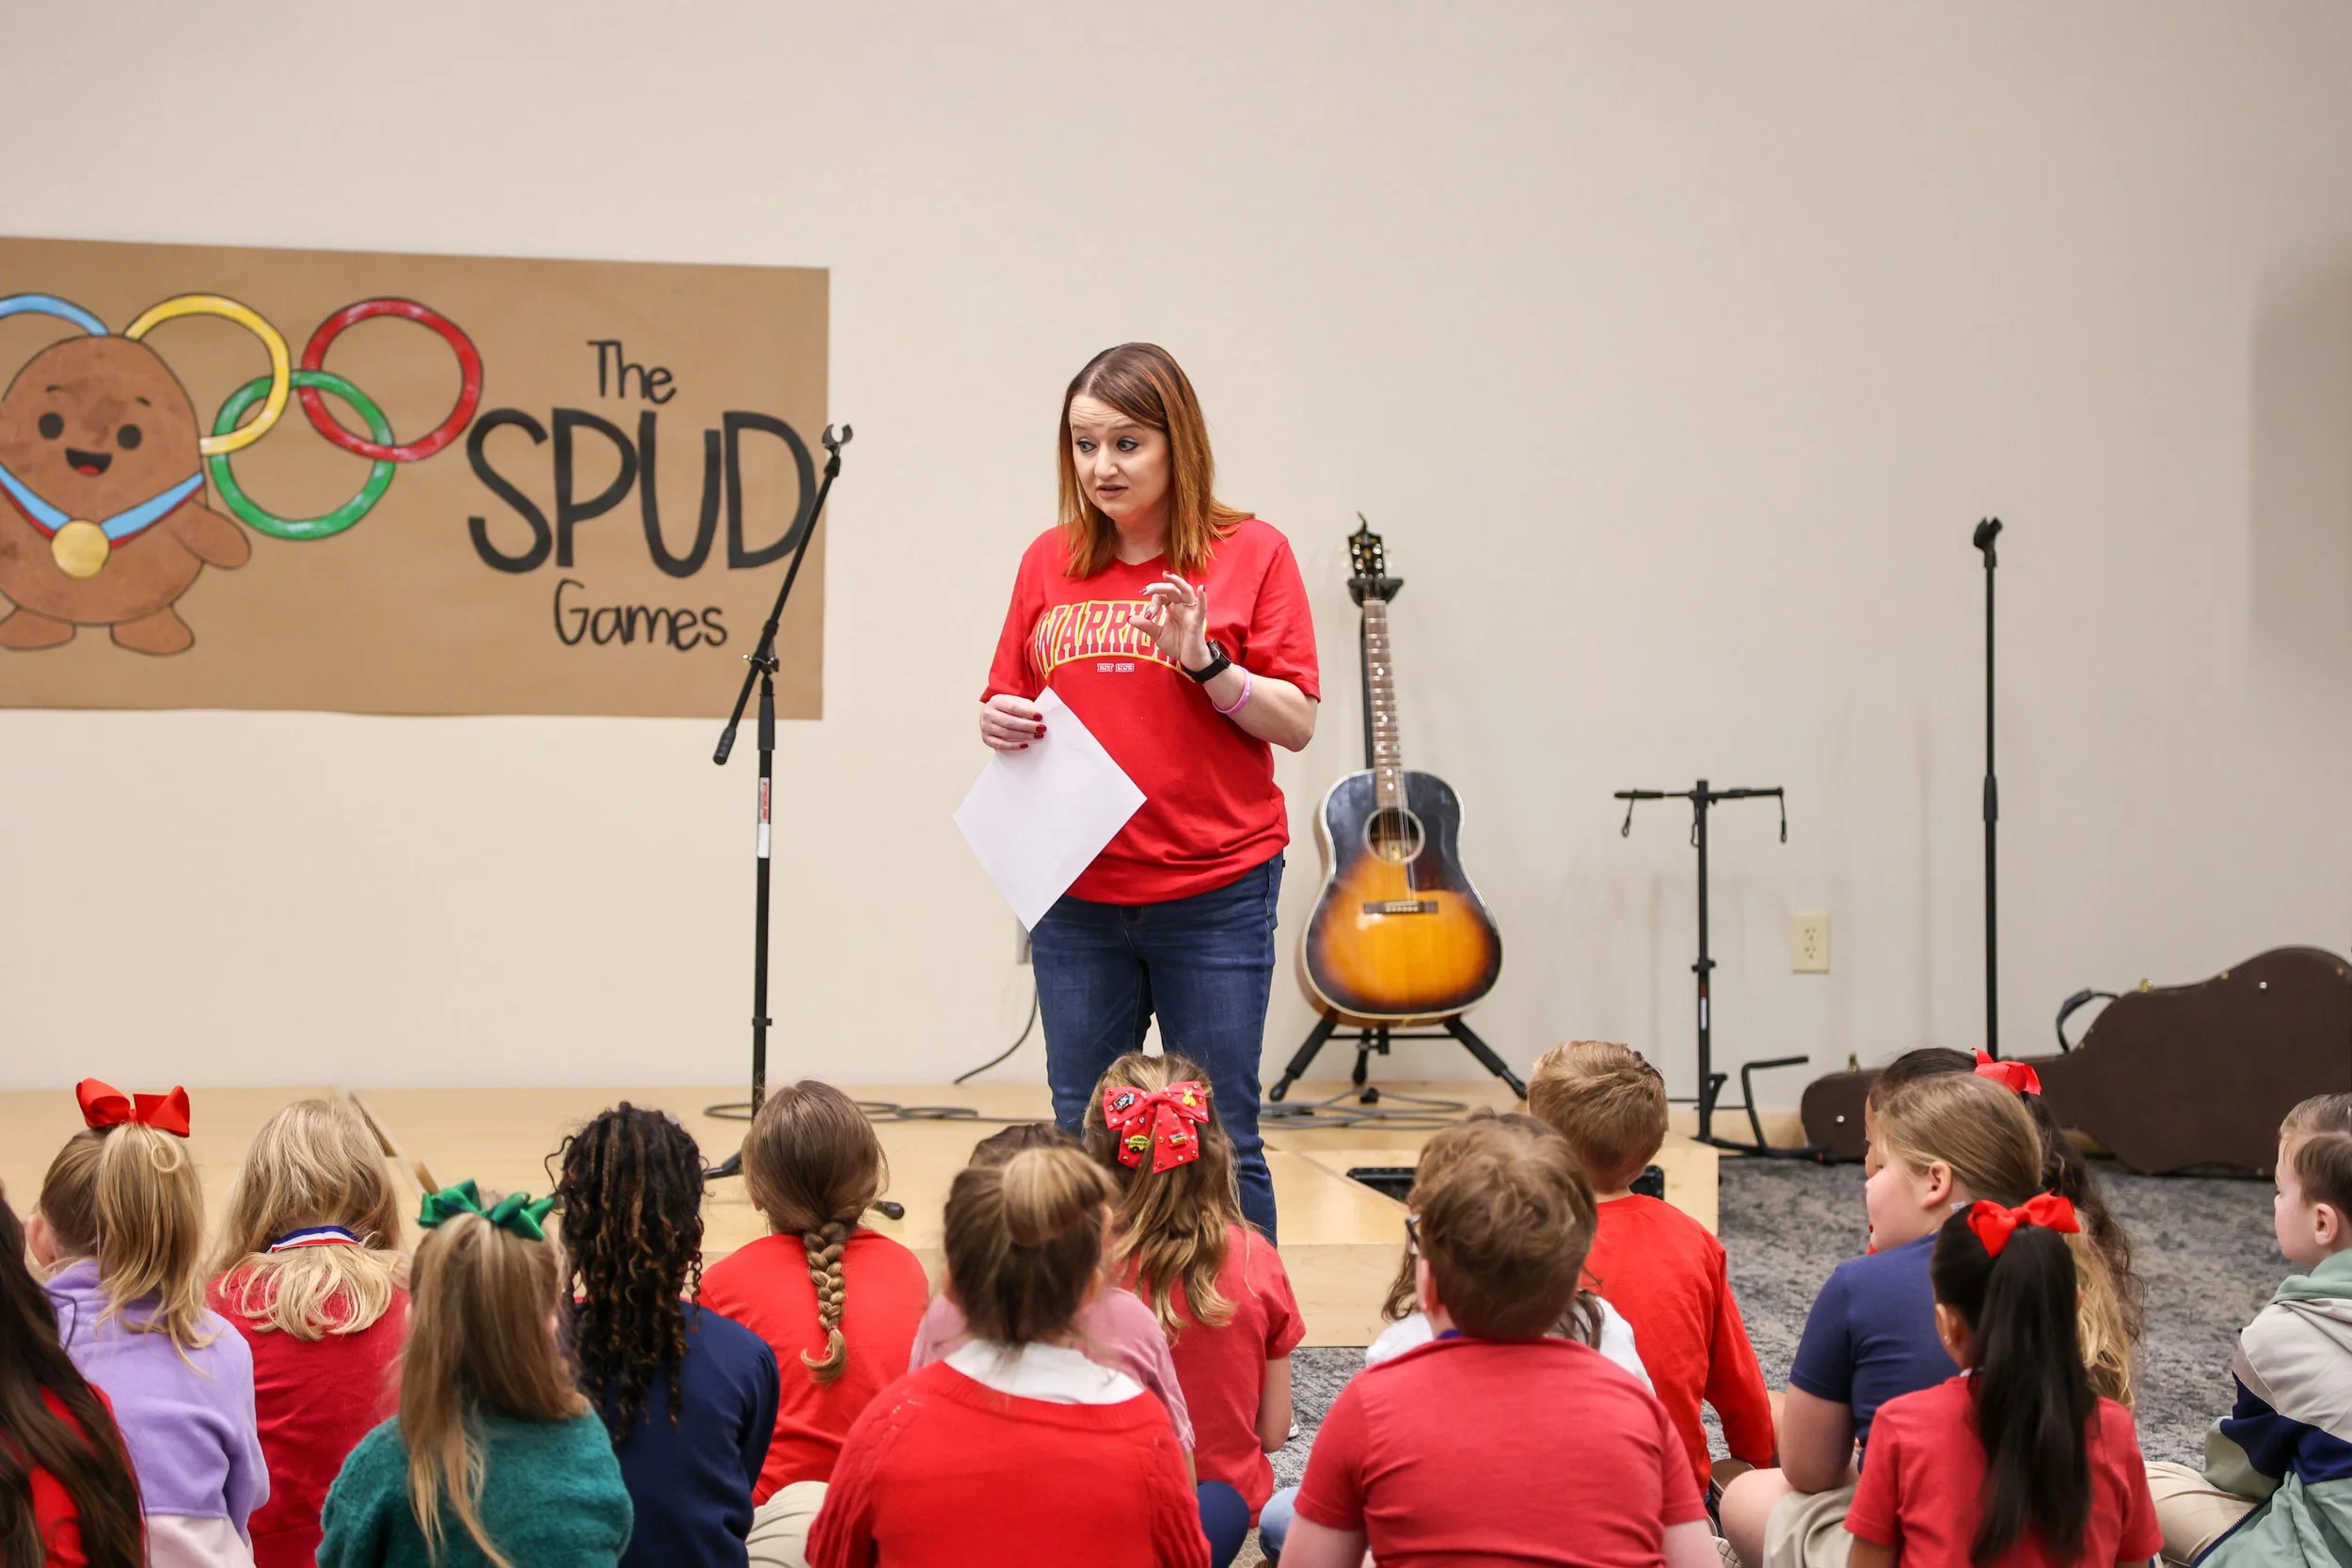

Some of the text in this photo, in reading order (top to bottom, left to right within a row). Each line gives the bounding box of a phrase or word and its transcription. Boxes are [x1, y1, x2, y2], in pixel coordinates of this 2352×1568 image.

[587, 340, 677, 404] The
[466, 407, 818, 578] SPUD
[553, 578, 728, 651] Games
[1096, 662, 1114, 673] EST
